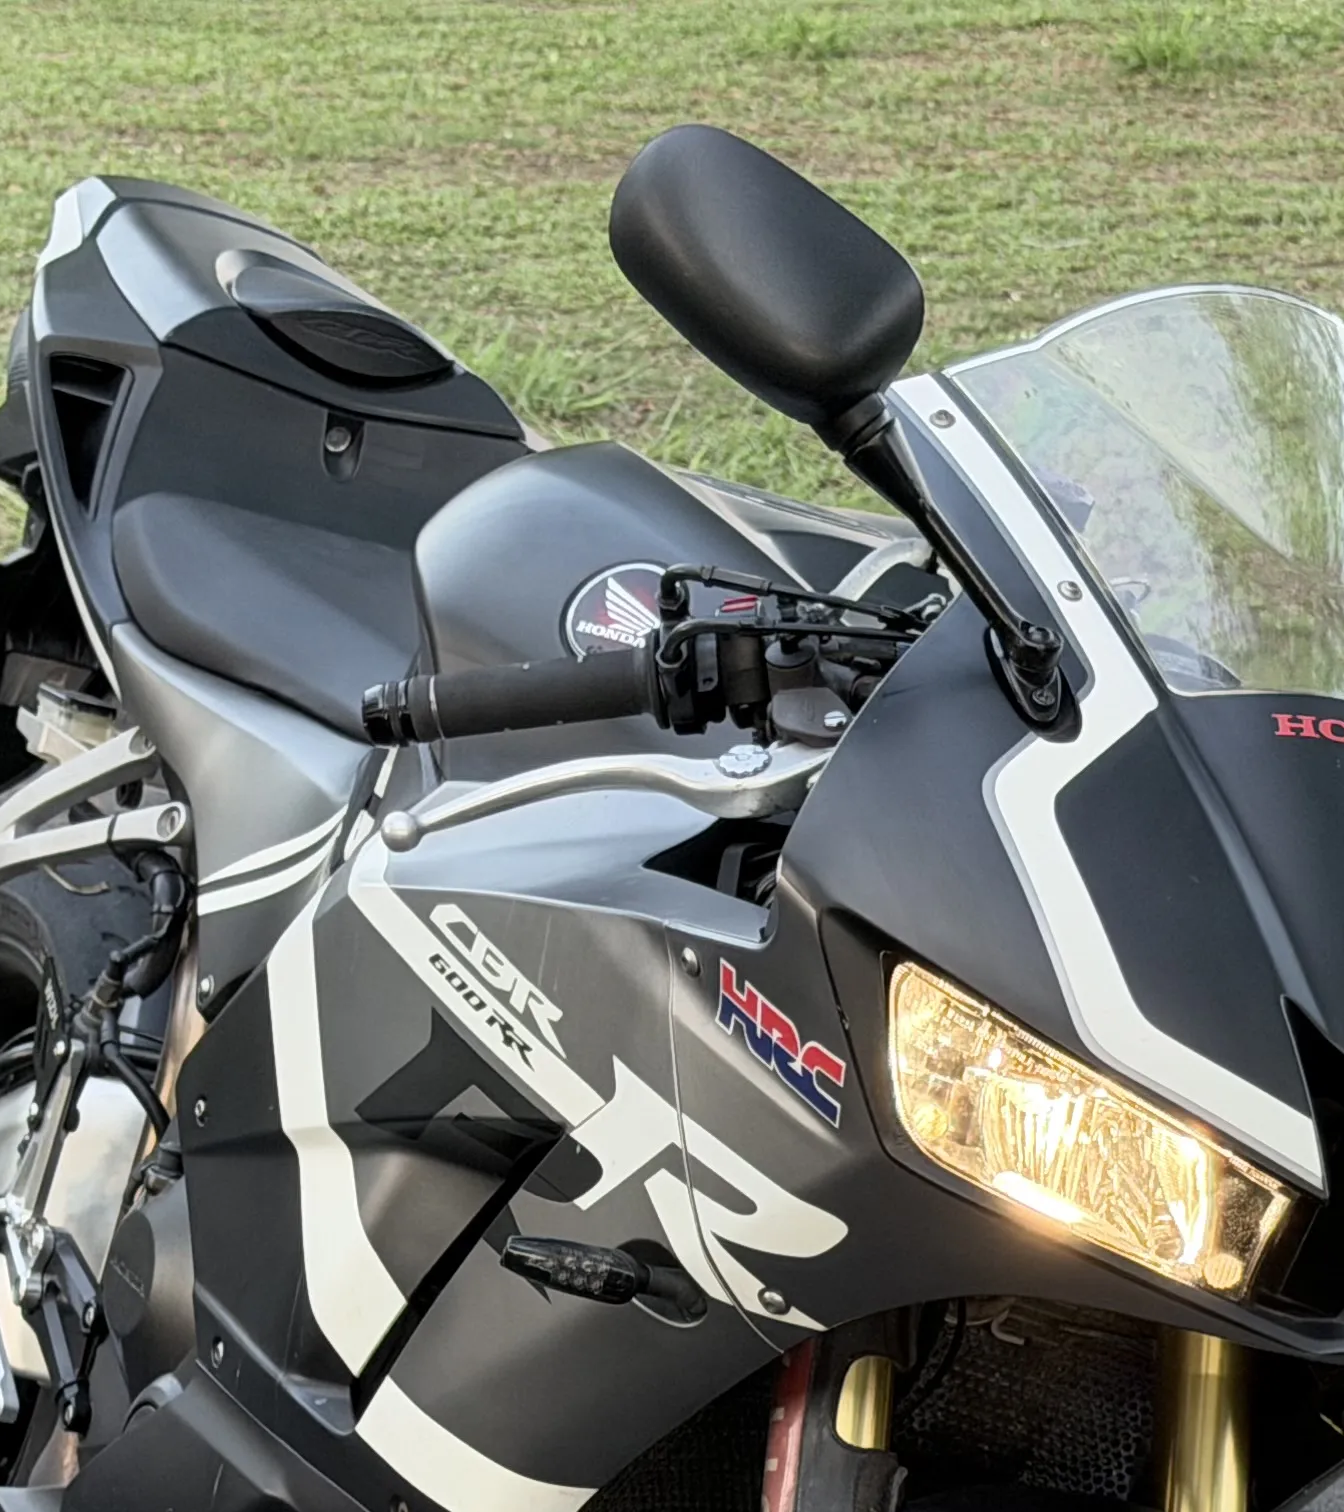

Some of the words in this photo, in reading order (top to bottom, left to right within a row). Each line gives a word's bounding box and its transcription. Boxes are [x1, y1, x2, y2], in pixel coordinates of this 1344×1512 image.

[576, 620, 646, 649] HONDA
[429, 903, 567, 1060] CBR
[715, 957, 846, 1129] HRC
